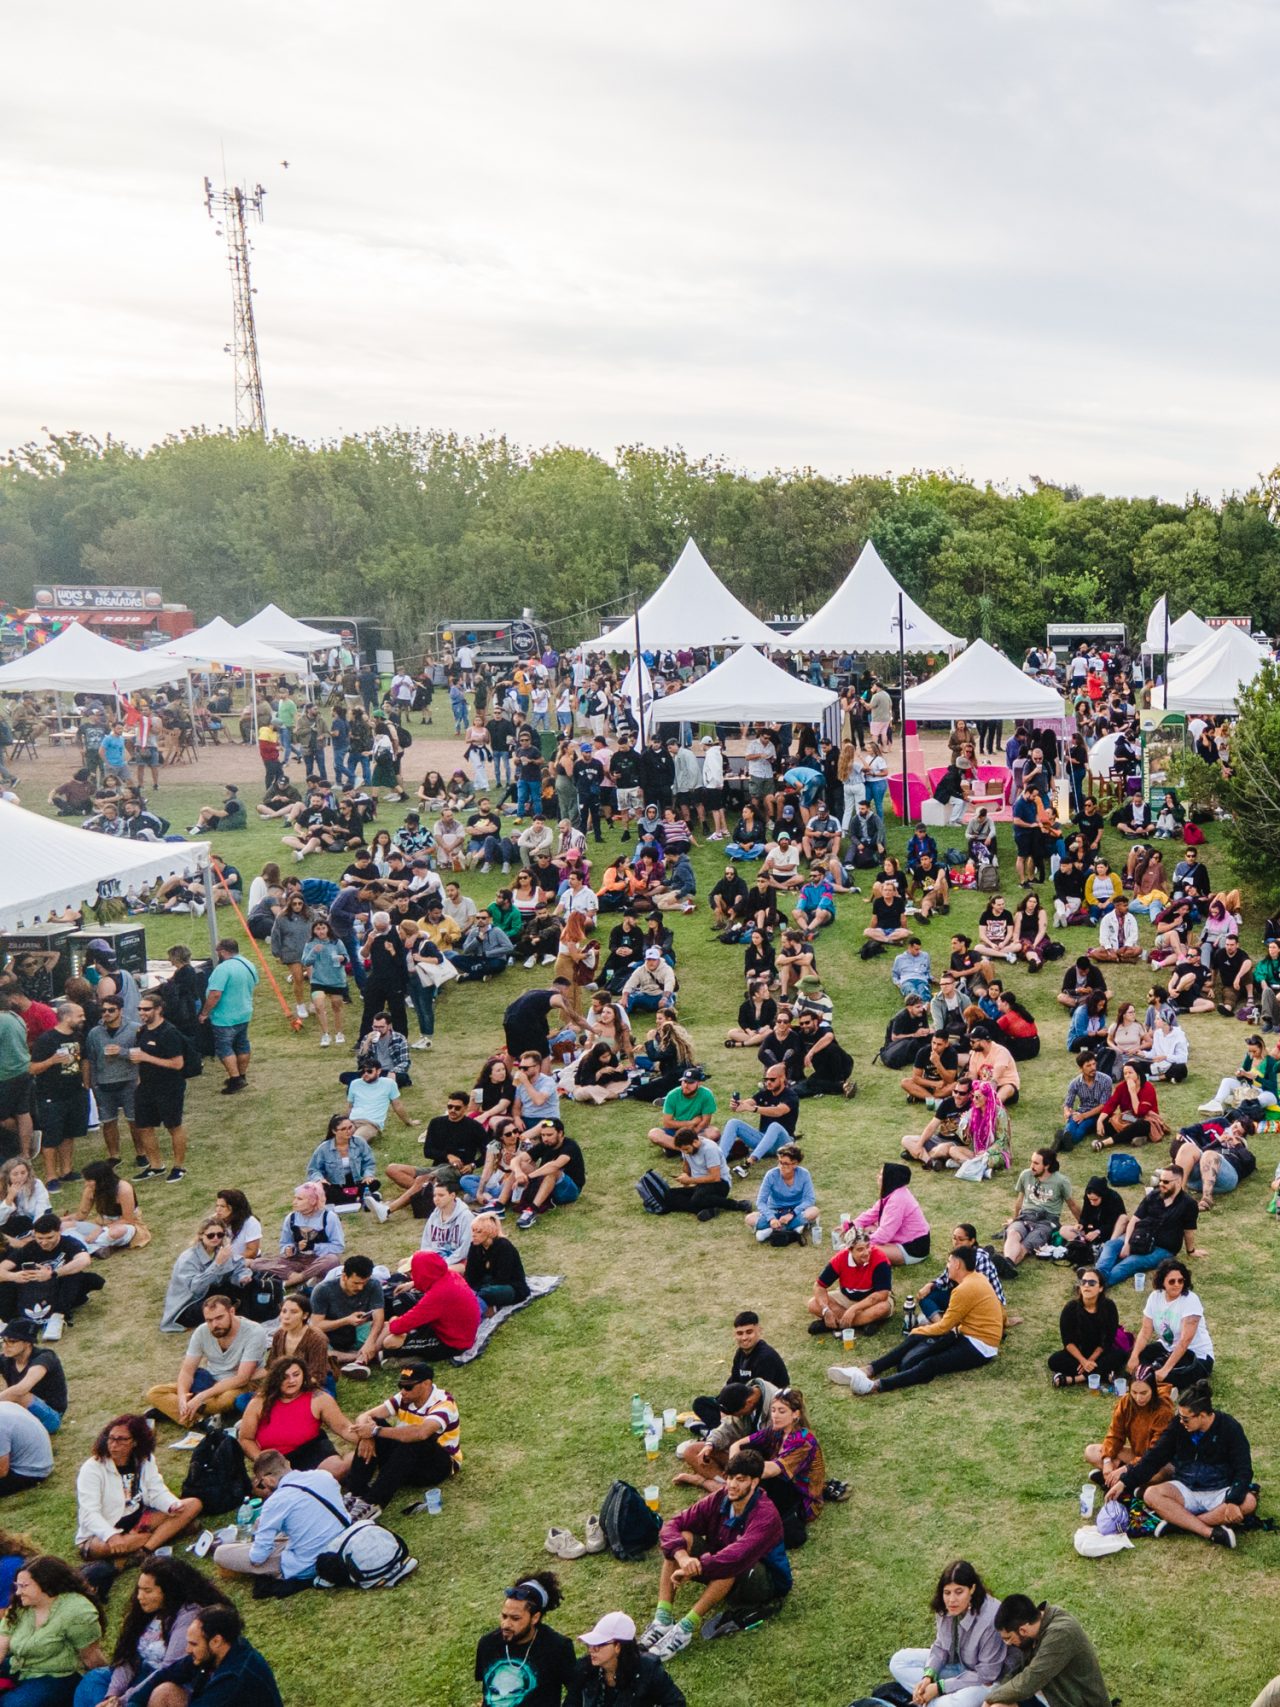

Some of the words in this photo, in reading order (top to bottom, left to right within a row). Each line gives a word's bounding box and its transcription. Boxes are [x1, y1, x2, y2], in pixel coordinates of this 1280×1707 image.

[58, 590, 83, 600] WOKS
[84, 590, 93, 600] &
[94, 597, 142, 607] ENSALADAS
